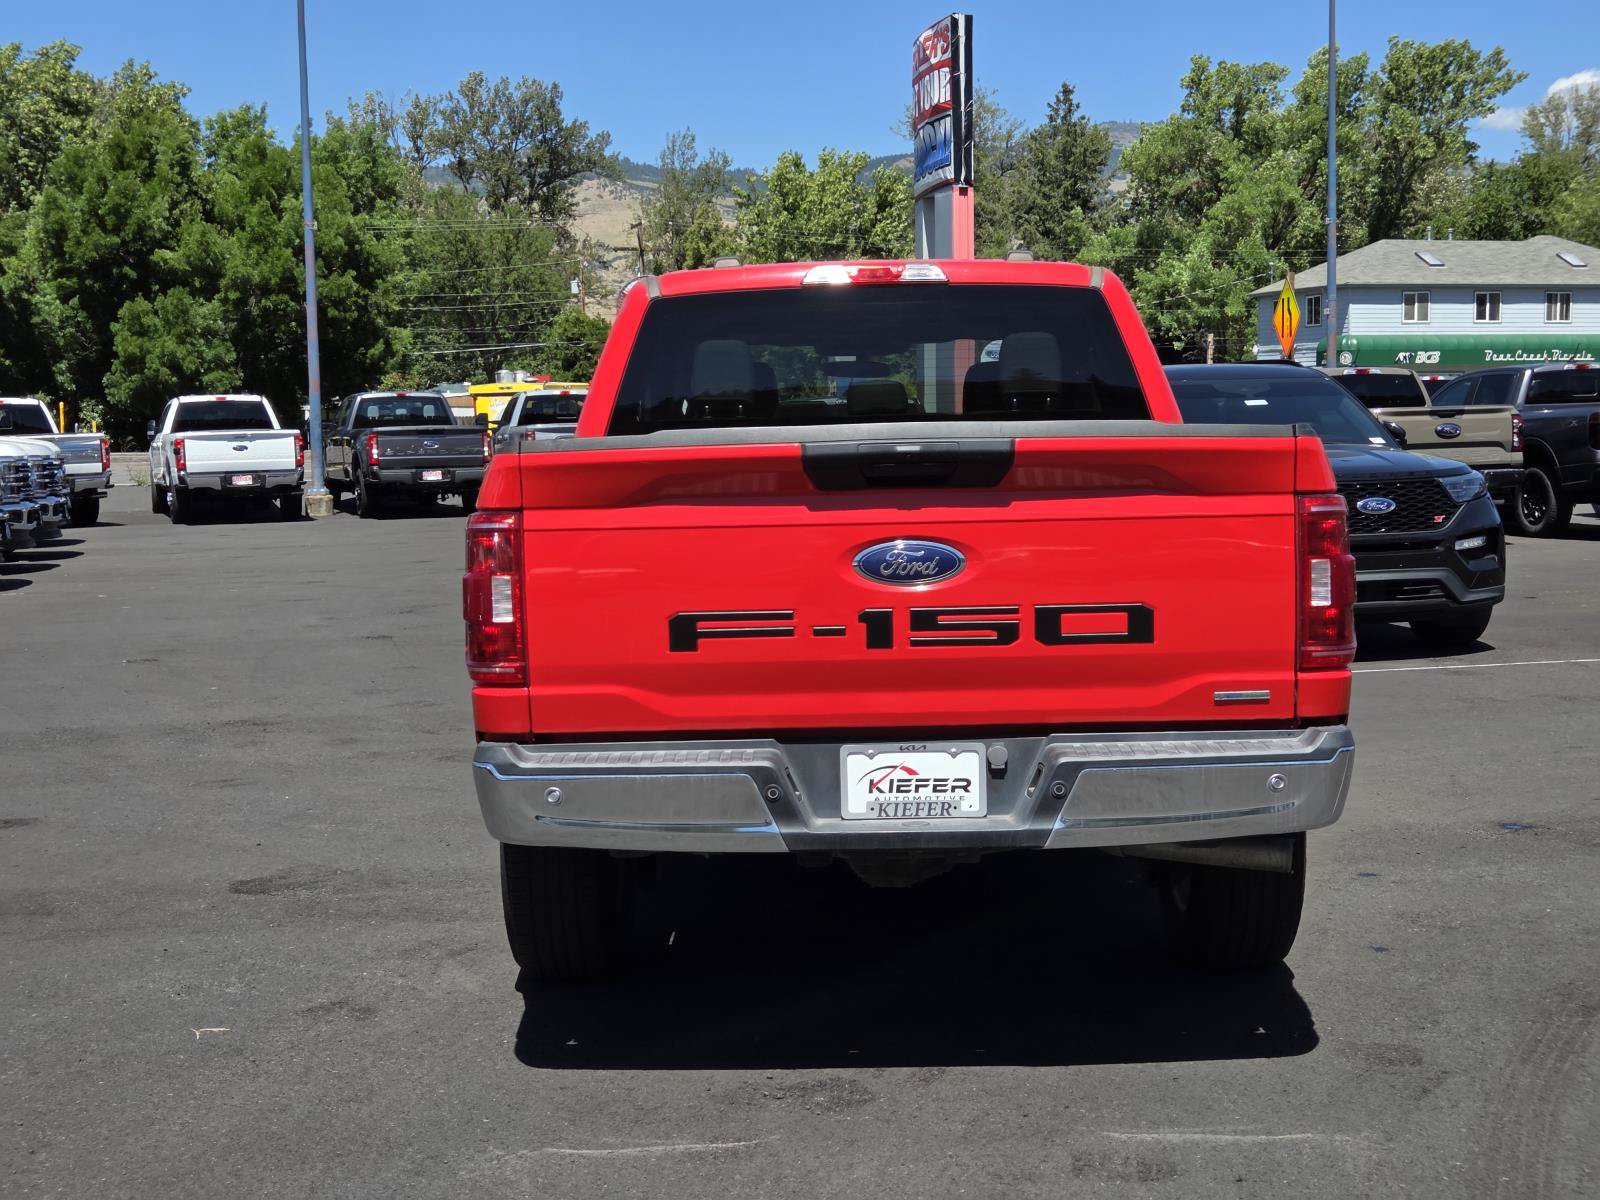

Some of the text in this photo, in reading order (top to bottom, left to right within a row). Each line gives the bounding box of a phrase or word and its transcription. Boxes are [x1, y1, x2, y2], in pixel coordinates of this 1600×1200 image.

[1415, 351, 1440, 363] BCB
[1485, 350, 1514, 361] Bear
[1515, 350, 1551, 362] Creek
[667, 602, 1155, 652] F-150
[868, 777, 972, 794] KIEFER
[876, 802, 953, 818] KIEFER
